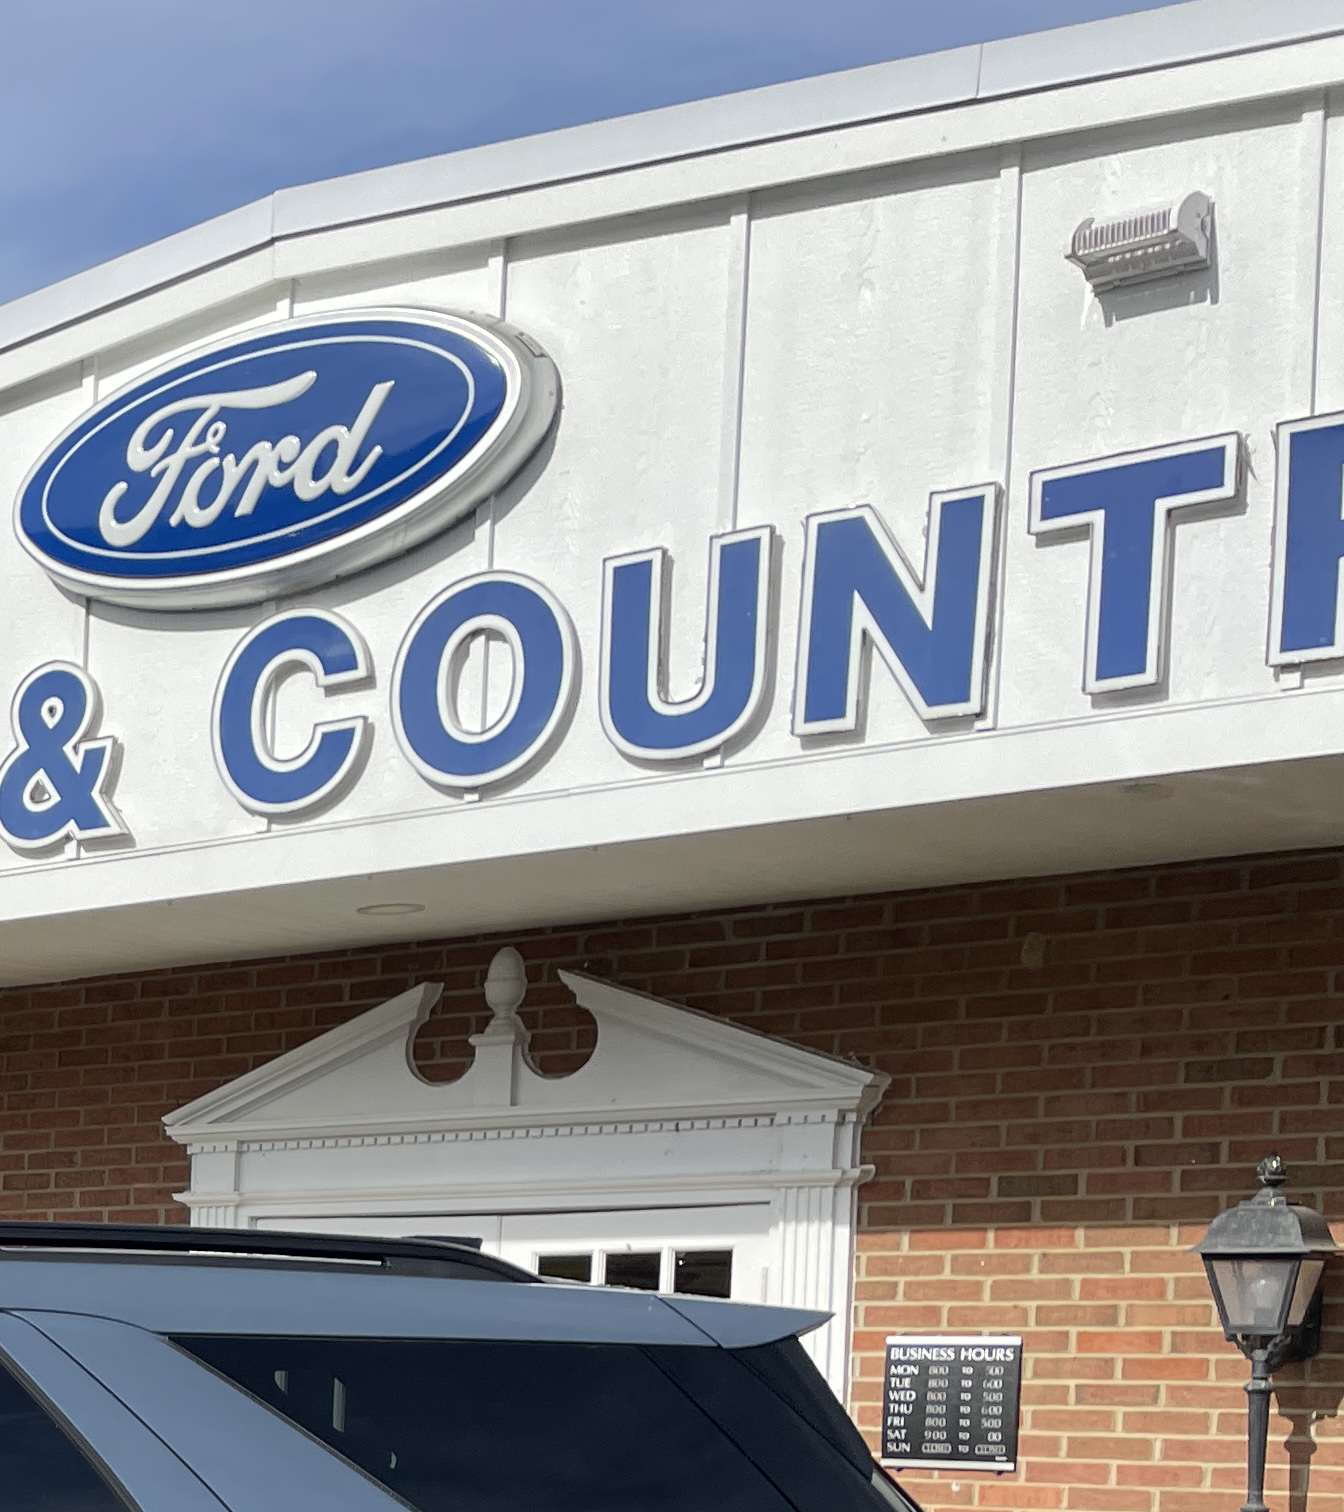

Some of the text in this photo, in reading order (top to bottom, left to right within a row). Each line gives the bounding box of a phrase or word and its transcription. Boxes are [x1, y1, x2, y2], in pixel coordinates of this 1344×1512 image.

[99, 370, 395, 548] Ford
[890, 1347, 1014, 1361] BUSINESS HOURS
[889, 1364, 919, 1375] MON
[890, 1377, 911, 1388] TUE
[889, 1390, 916, 1401] WED
[889, 1403, 912, 1415] THU
[887, 1416, 905, 1427] FRI
[887, 1429, 907, 1440] SAT
[886, 1442, 911, 1453] SUN
